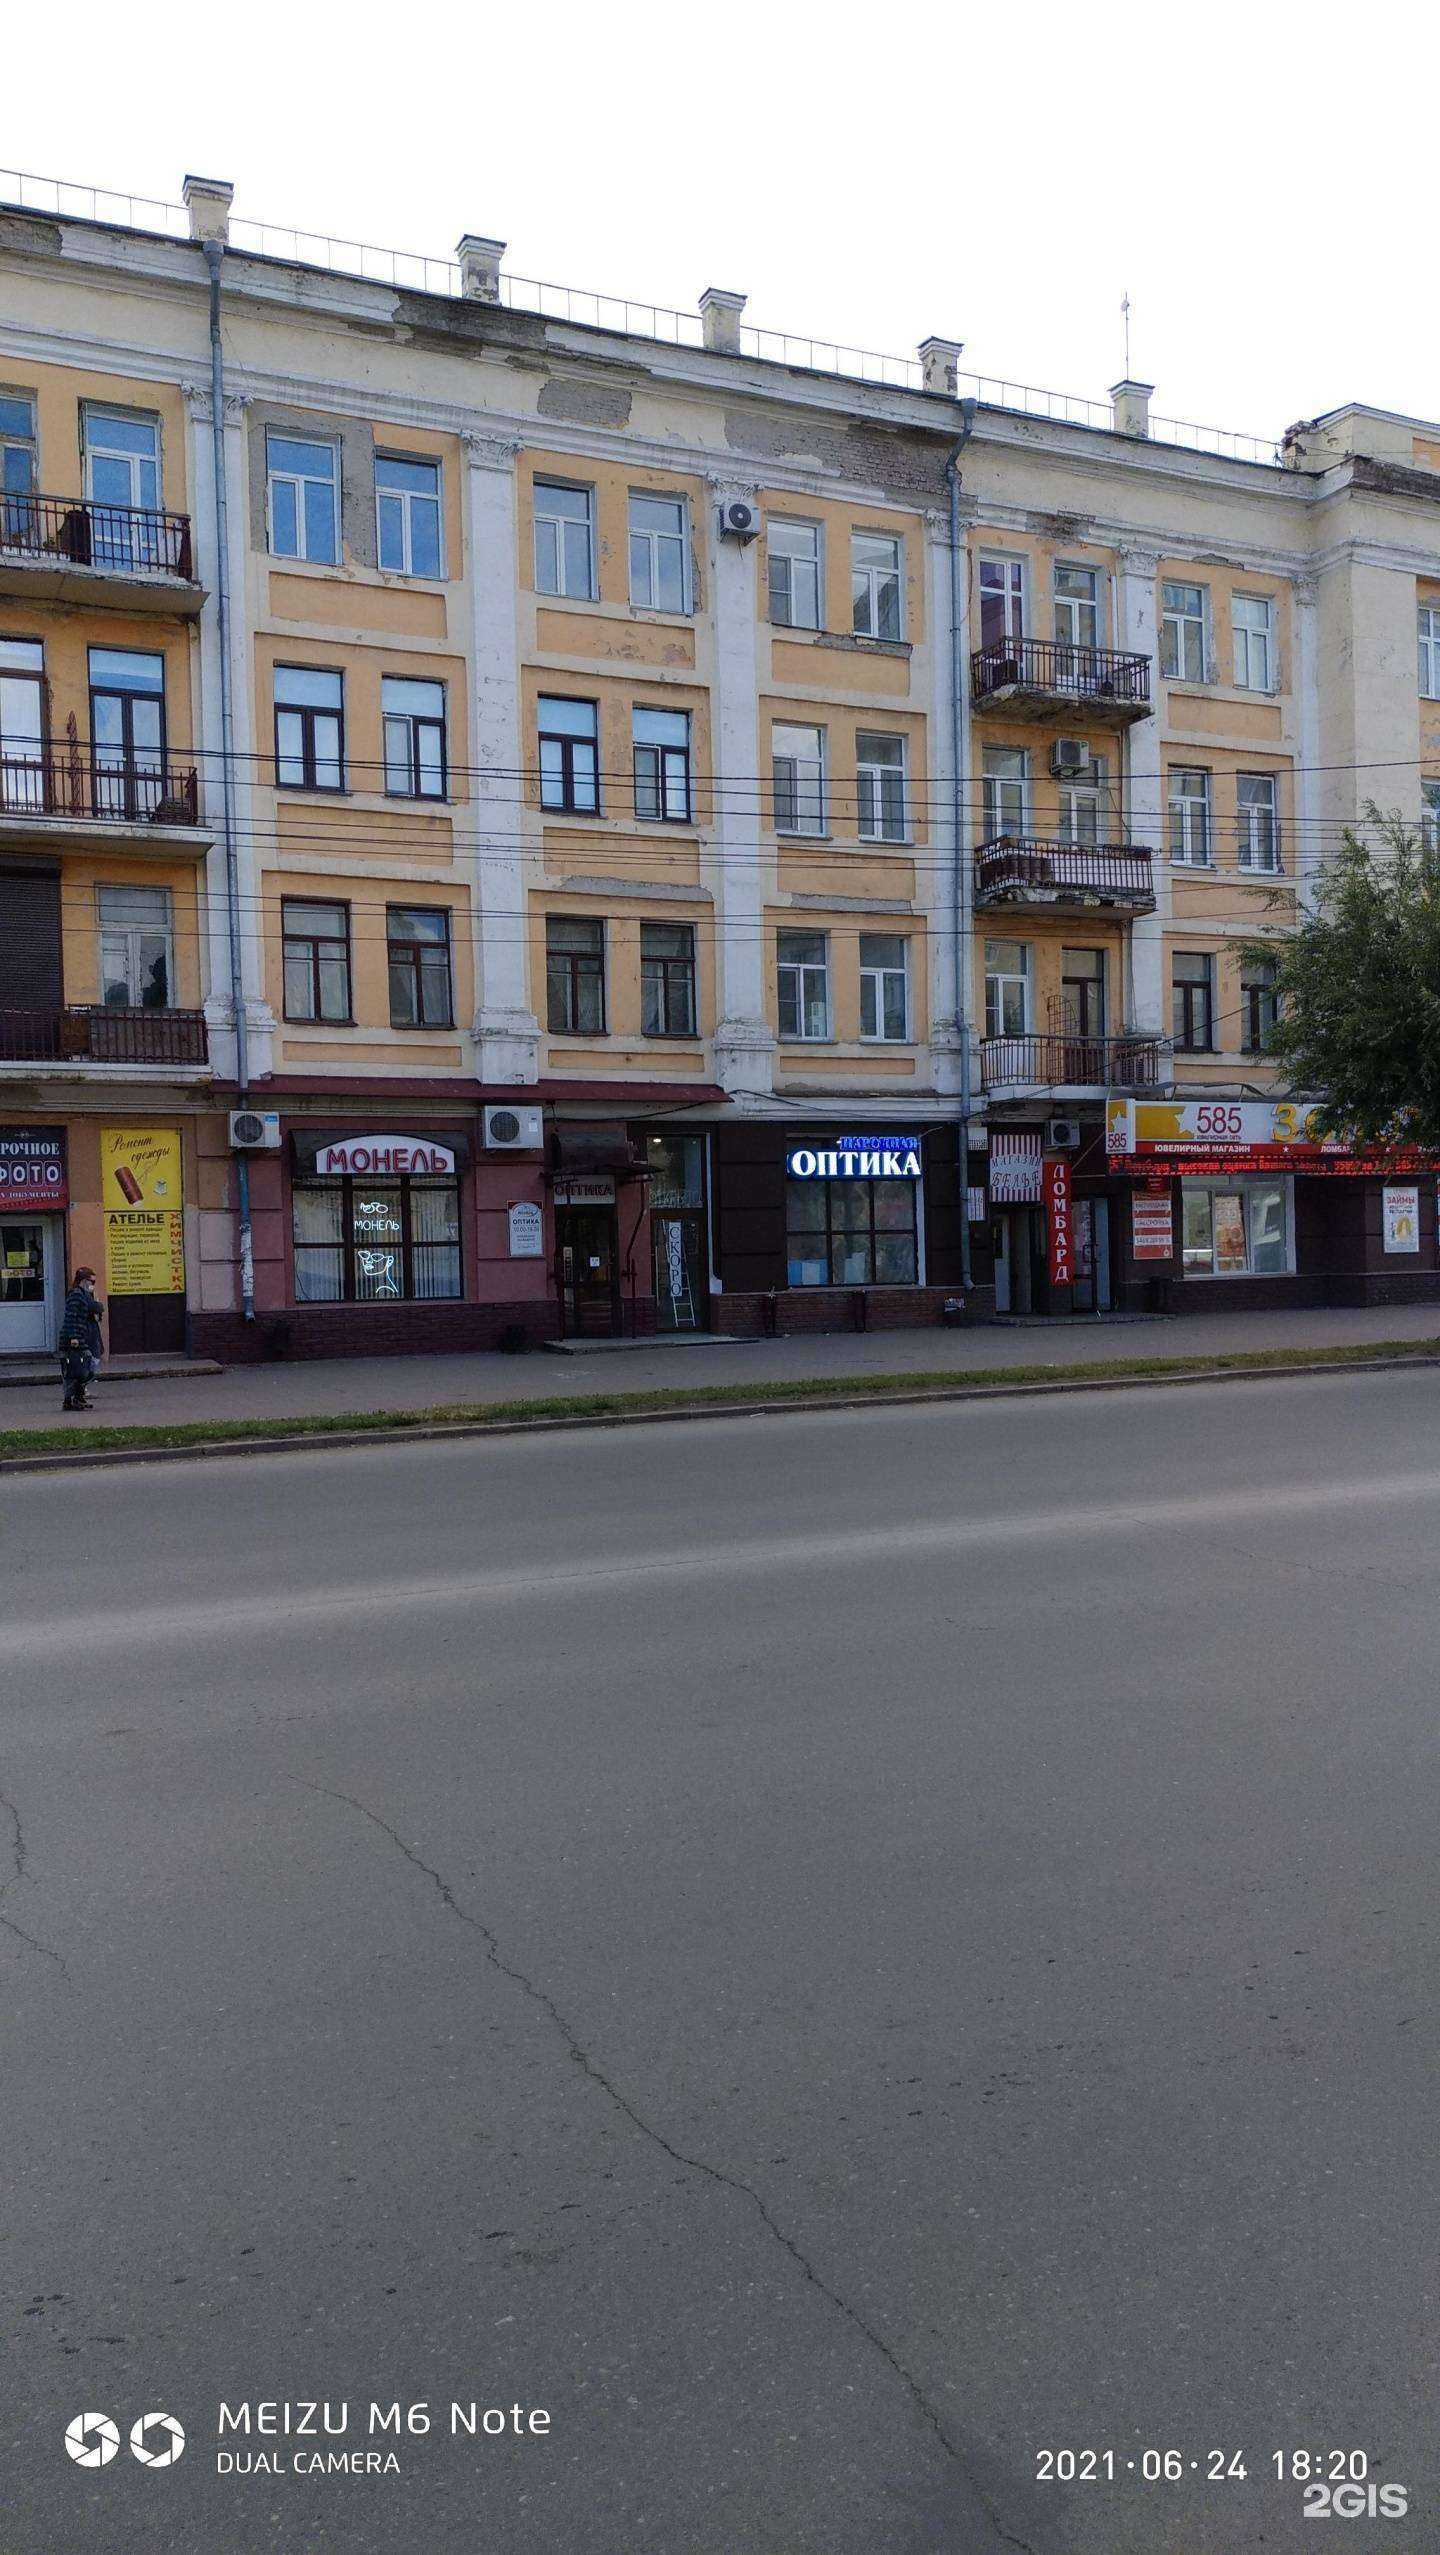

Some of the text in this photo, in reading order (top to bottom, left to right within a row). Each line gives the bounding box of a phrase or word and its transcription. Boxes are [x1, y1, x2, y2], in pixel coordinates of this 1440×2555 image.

[1196, 1106, 1242, 1134] 585
[1108, 1133, 1127, 1148] 585
[1154, 1143, 1251, 1153] ЮВЕЛИРНЫЙ МАГАЗИН
[326, 1148, 448, 1172] МОНЕЛЬ
[791, 1150, 921, 1176] ОПТИКА
[991, 1154, 1042, 1167] МАГАЗИН
[109, 1213, 165, 1224] АТЕЛЬЕ
[354, 1219, 400, 1231] МОНЕЛЬ
[1053, 1164, 1069, 1282] ЛОМБАРД
[170, 1212, 183, 1291] ХИМЧИСТКА
[669, 1226, 682, 1296] СКОРО
